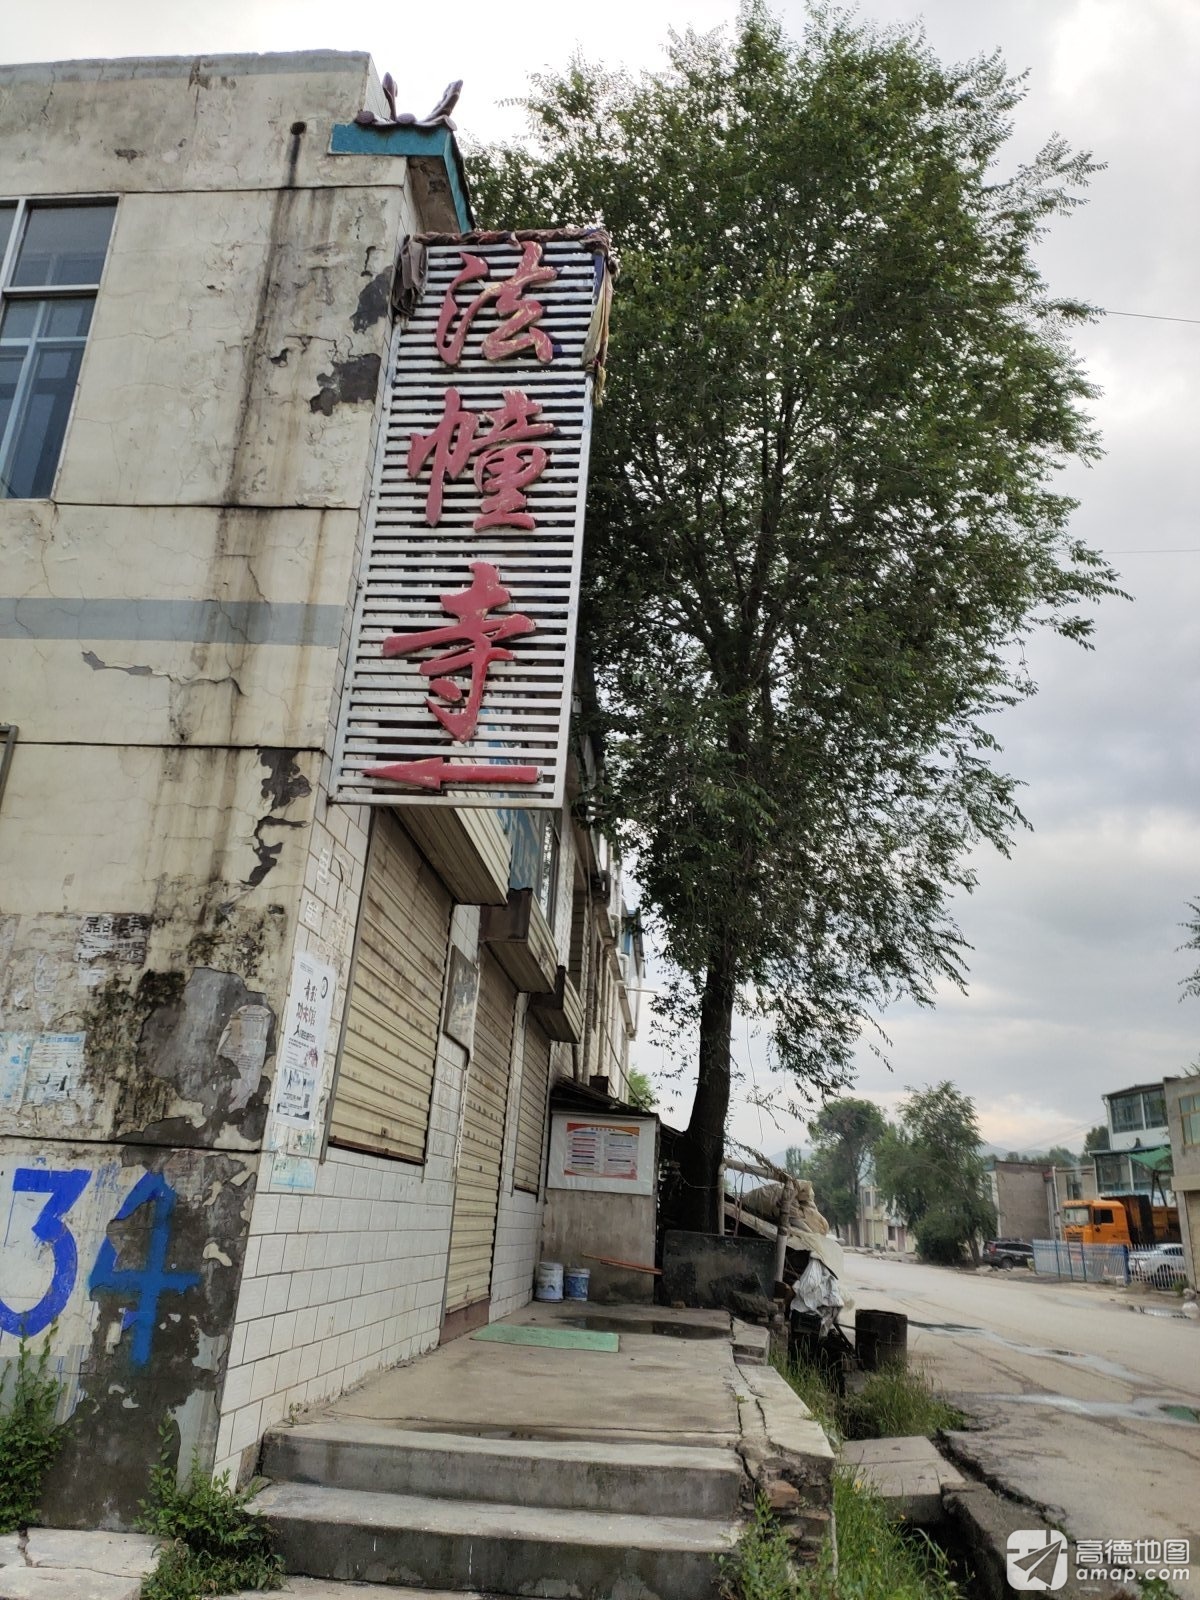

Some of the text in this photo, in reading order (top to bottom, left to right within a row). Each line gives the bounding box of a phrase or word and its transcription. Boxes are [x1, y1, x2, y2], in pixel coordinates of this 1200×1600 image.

[383, 240, 558, 742] 法幢寺
[0, 1168, 201, 1366] 34
